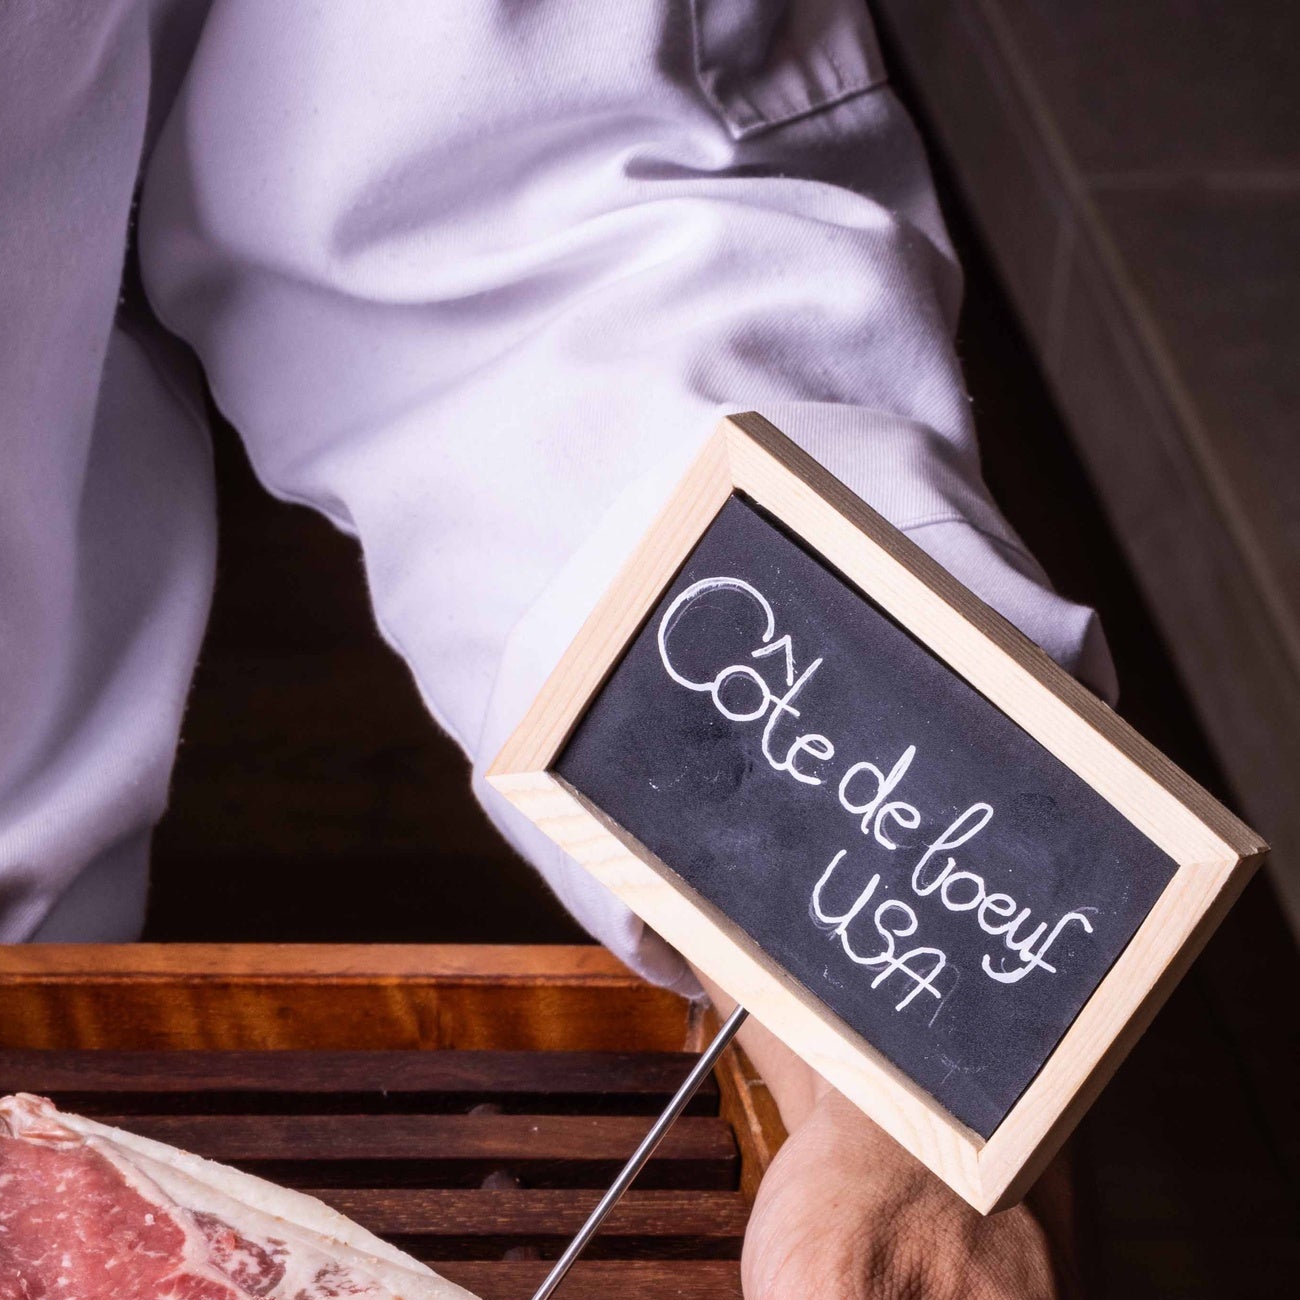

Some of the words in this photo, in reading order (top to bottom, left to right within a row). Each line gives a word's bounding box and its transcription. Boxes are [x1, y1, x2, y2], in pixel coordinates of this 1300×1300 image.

[660, 577, 835, 785] Côte
[838, 746, 919, 850] de
[913, 803, 1094, 983] boeuf
[813, 850, 947, 1011] USA
